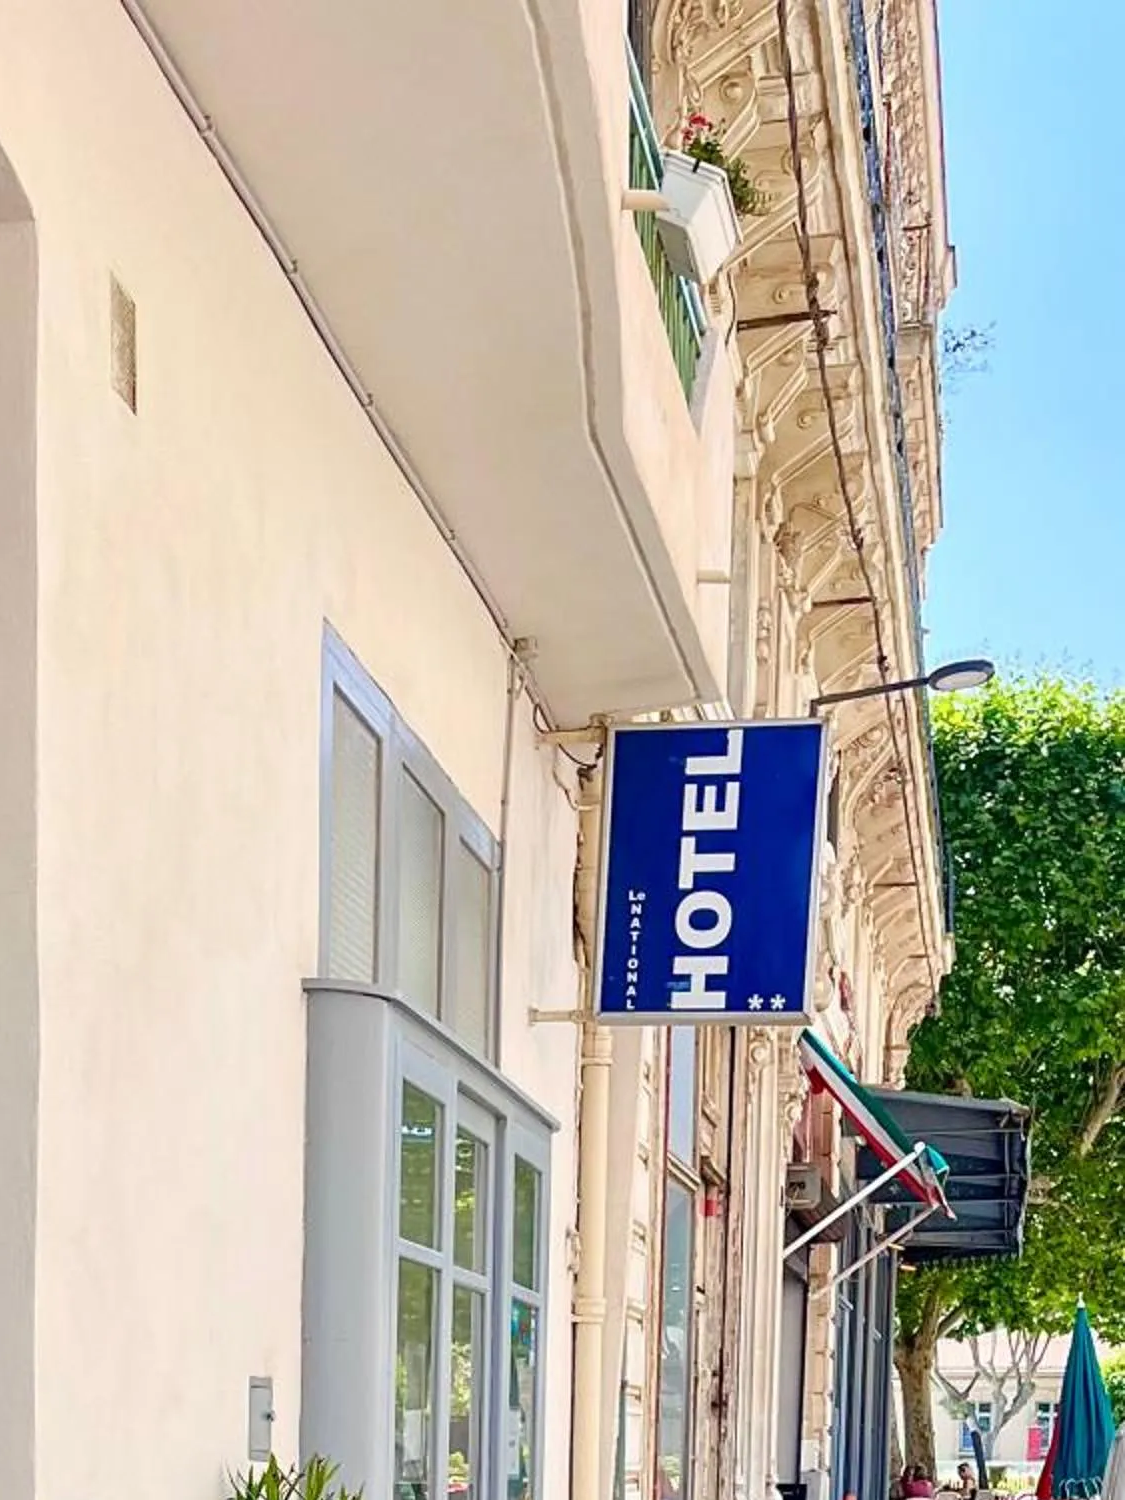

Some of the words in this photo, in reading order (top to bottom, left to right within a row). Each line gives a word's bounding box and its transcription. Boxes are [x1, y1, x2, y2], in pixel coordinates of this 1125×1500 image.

[628, 889, 646, 901] Le
[670, 729, 743, 1009] HOTEL
[626, 903, 642, 1010] NATIONAL
